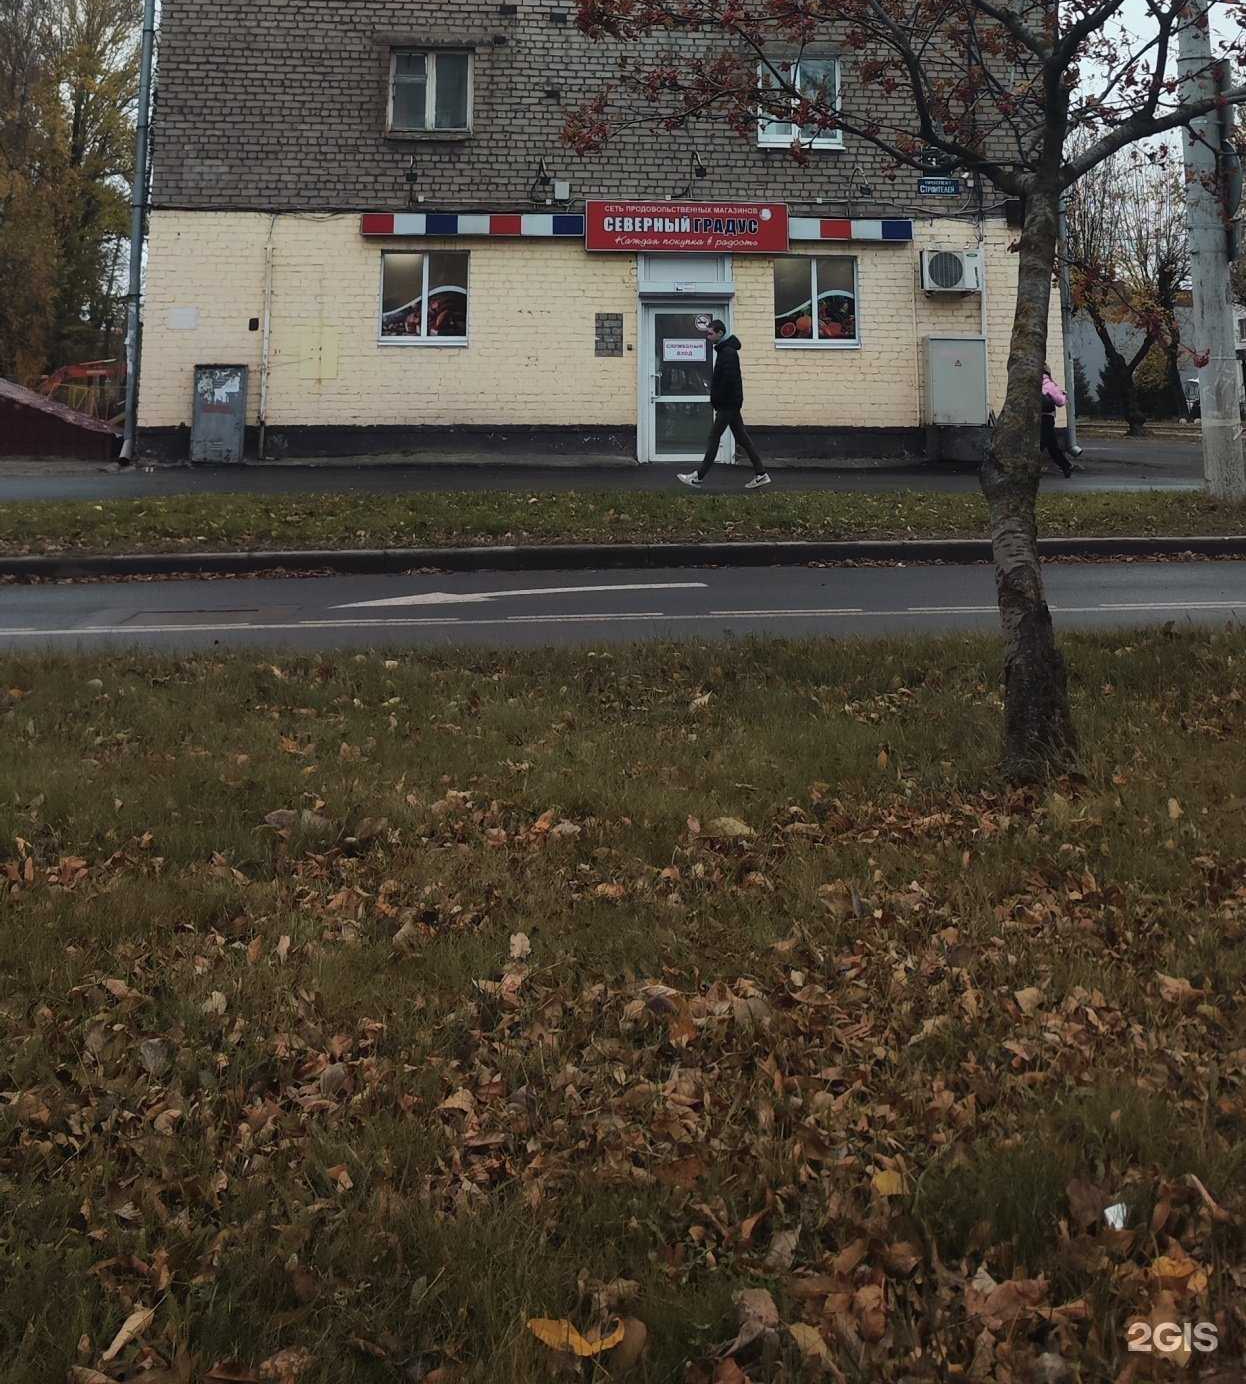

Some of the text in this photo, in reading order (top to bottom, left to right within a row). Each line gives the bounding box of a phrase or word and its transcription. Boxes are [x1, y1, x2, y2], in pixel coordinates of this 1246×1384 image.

[604, 205, 624, 213] СЕТЬ
[625, 205, 712, 214] ПРОДОВОЛЬСТВЕННЫХ
[603, 216, 759, 236] СЕВЕРНЫЙ ГРАДУС
[615, 236, 660, 247] Каждая
[662, 238, 704, 248] покупка
[714, 239, 759, 249] радость
